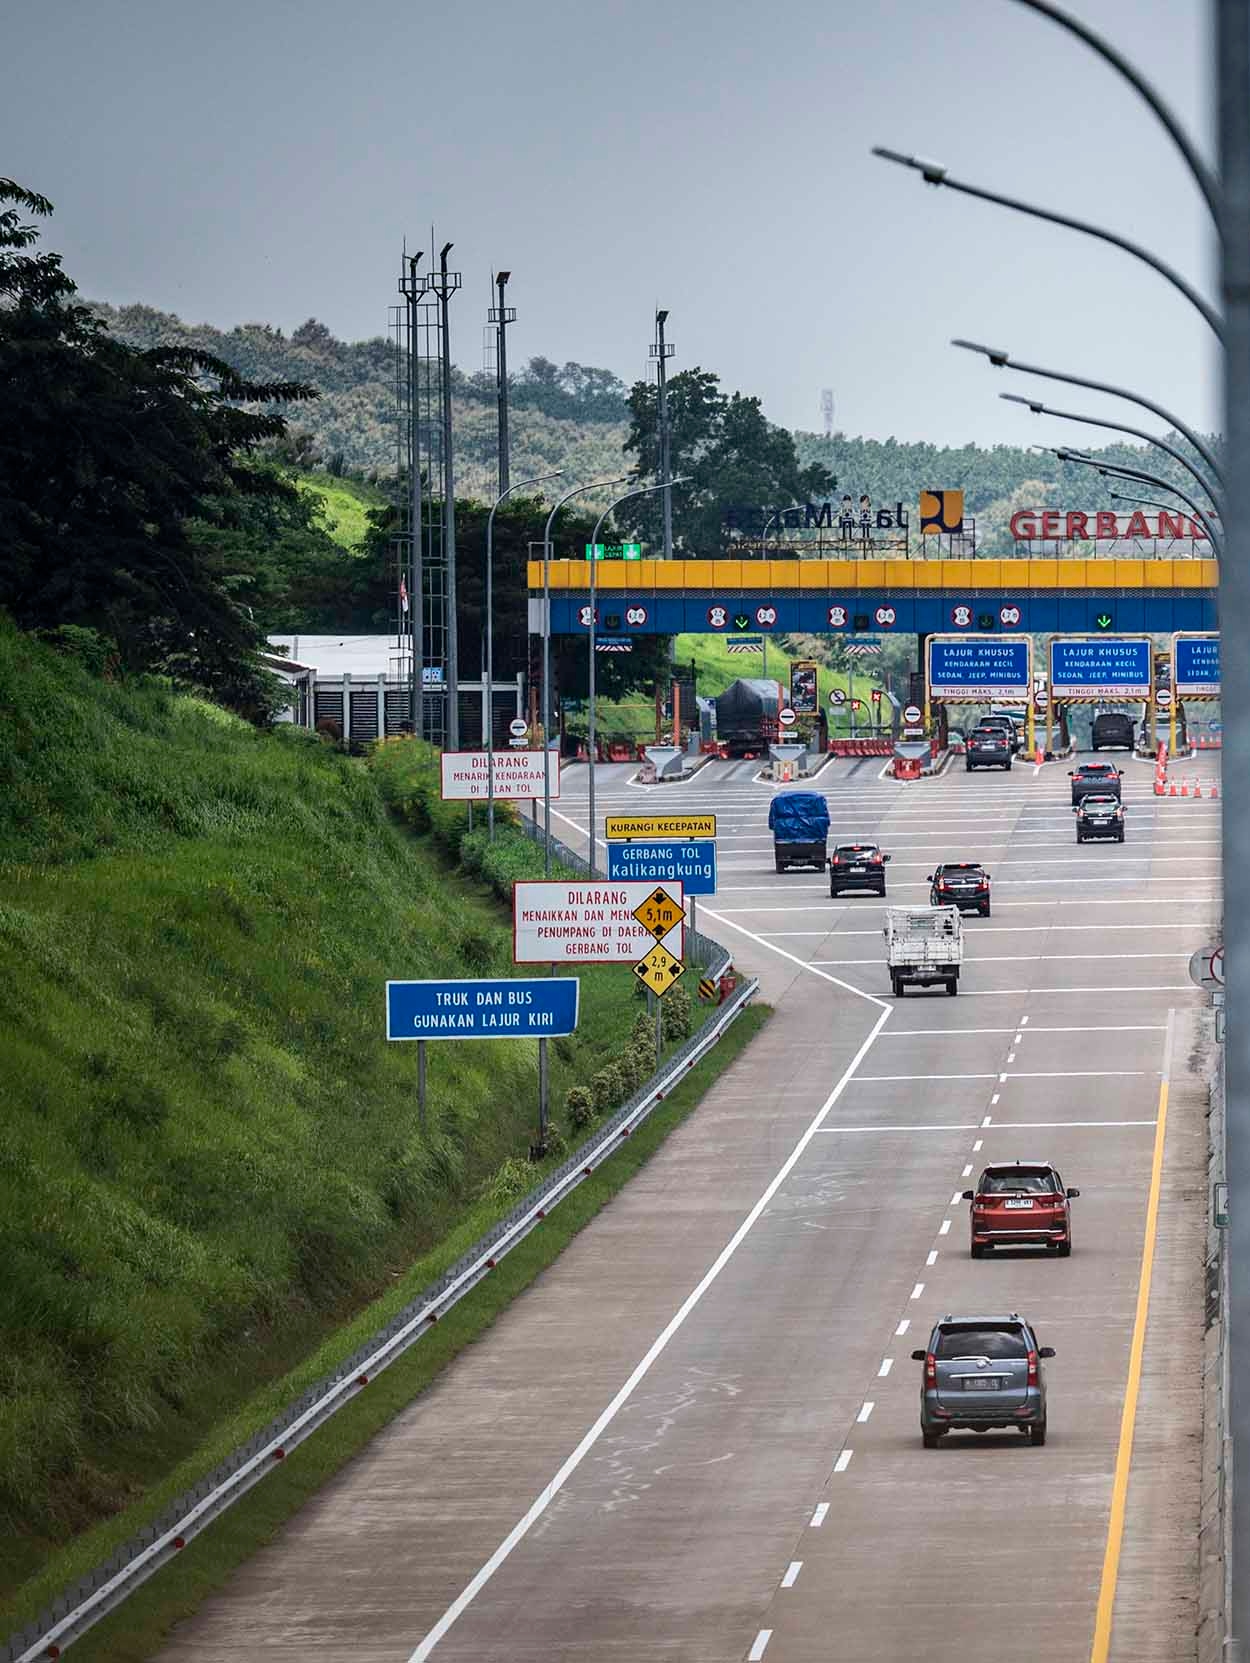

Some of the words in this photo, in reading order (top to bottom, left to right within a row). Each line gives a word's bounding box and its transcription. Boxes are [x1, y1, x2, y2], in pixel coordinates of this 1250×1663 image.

[944, 648, 972, 656] LAJUR
[978, 648, 1014, 656] KHUSUS
[1063, 648, 1094, 656] LAJUR
[1098, 648, 1138, 656] KHUSUS
[1191, 646, 1218, 654] LAJUR
[472, 757, 528, 768] DILARANG
[485, 784, 512, 793] JLAN
[516, 784, 532, 792] TOL
[610, 823, 654, 833] KURANGI
[657, 822, 712, 832] KECEPATAN
[622, 848, 673, 860] GERBANG
[680, 848, 700, 859] TOL
[612, 862, 712, 880] Kalikangkung
[568, 891, 628, 905] DILARANG
[522, 910, 578, 922] MENAIKKAN
[584, 910, 604, 921] DAN
[538, 927, 596, 938] PENUMPANG
[602, 927, 612, 937] DI
[618, 926, 650, 937] DAERA
[566, 943, 610, 954] GERBANG
[616, 943, 633, 954] TOL
[651, 956, 666, 968] 2,9
[654, 972, 664, 982] m
[436, 992, 468, 1006] TRUK
[476, 992, 502, 1006] DAN
[508, 991, 533, 1005] BUS
[414, 1014, 474, 1028] GUNAKAN
[482, 1012, 520, 1026] LAJUR
[528, 1012, 554, 1026] KIRI
